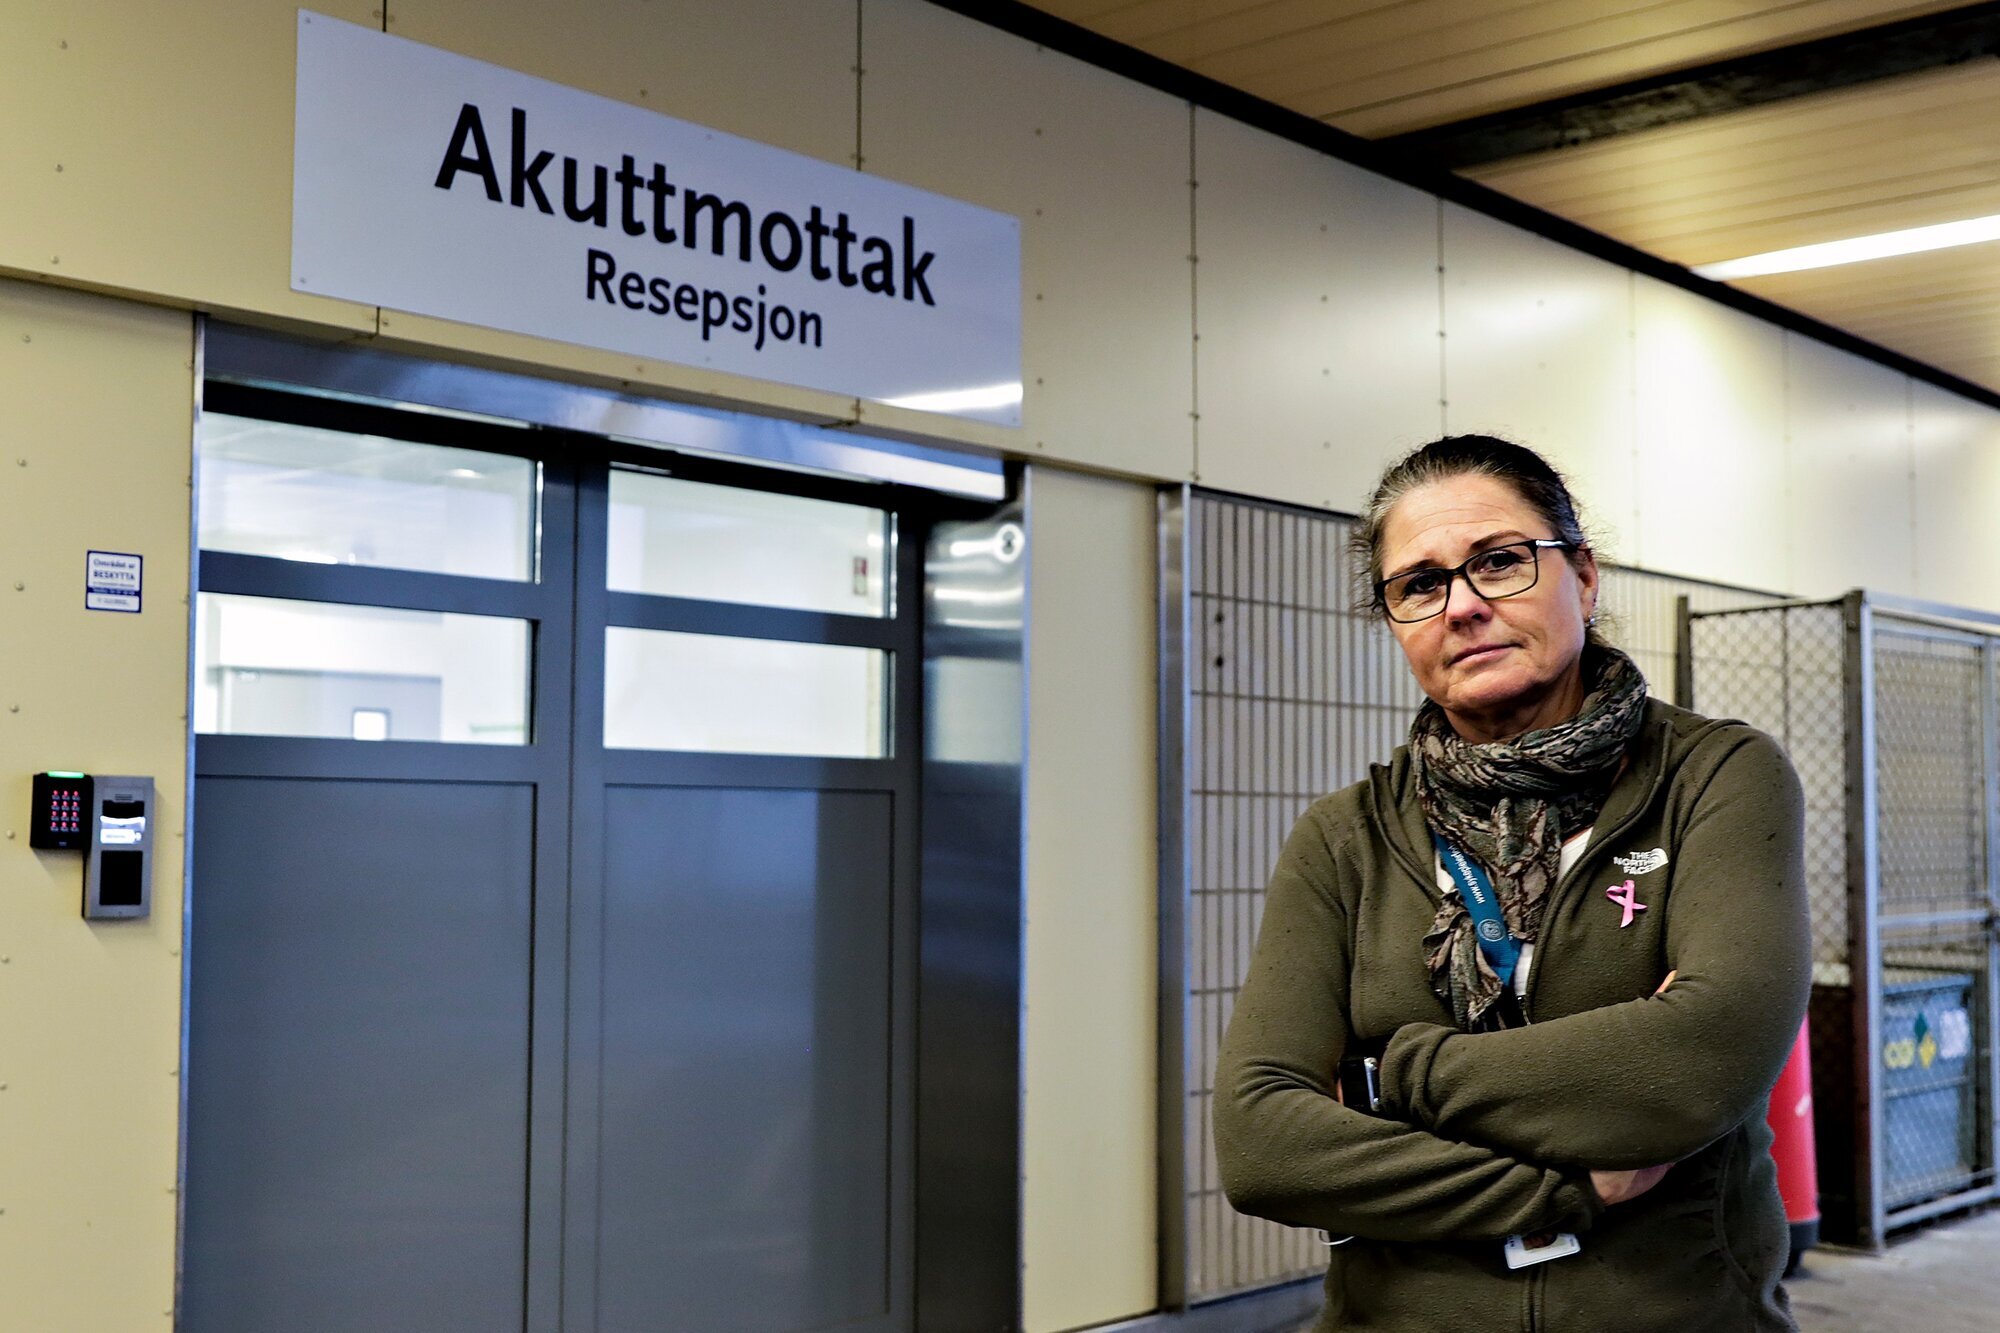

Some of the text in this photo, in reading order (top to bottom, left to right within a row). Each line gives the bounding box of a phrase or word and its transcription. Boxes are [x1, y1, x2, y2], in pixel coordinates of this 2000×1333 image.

[434, 102, 936, 307] Akuttmottak
[586, 248, 823, 351] Resepsjon
[1629, 851, 1651, 860] THE
[1613, 856, 1652, 867] NORTH
[1623, 865, 1652, 875] FACE
